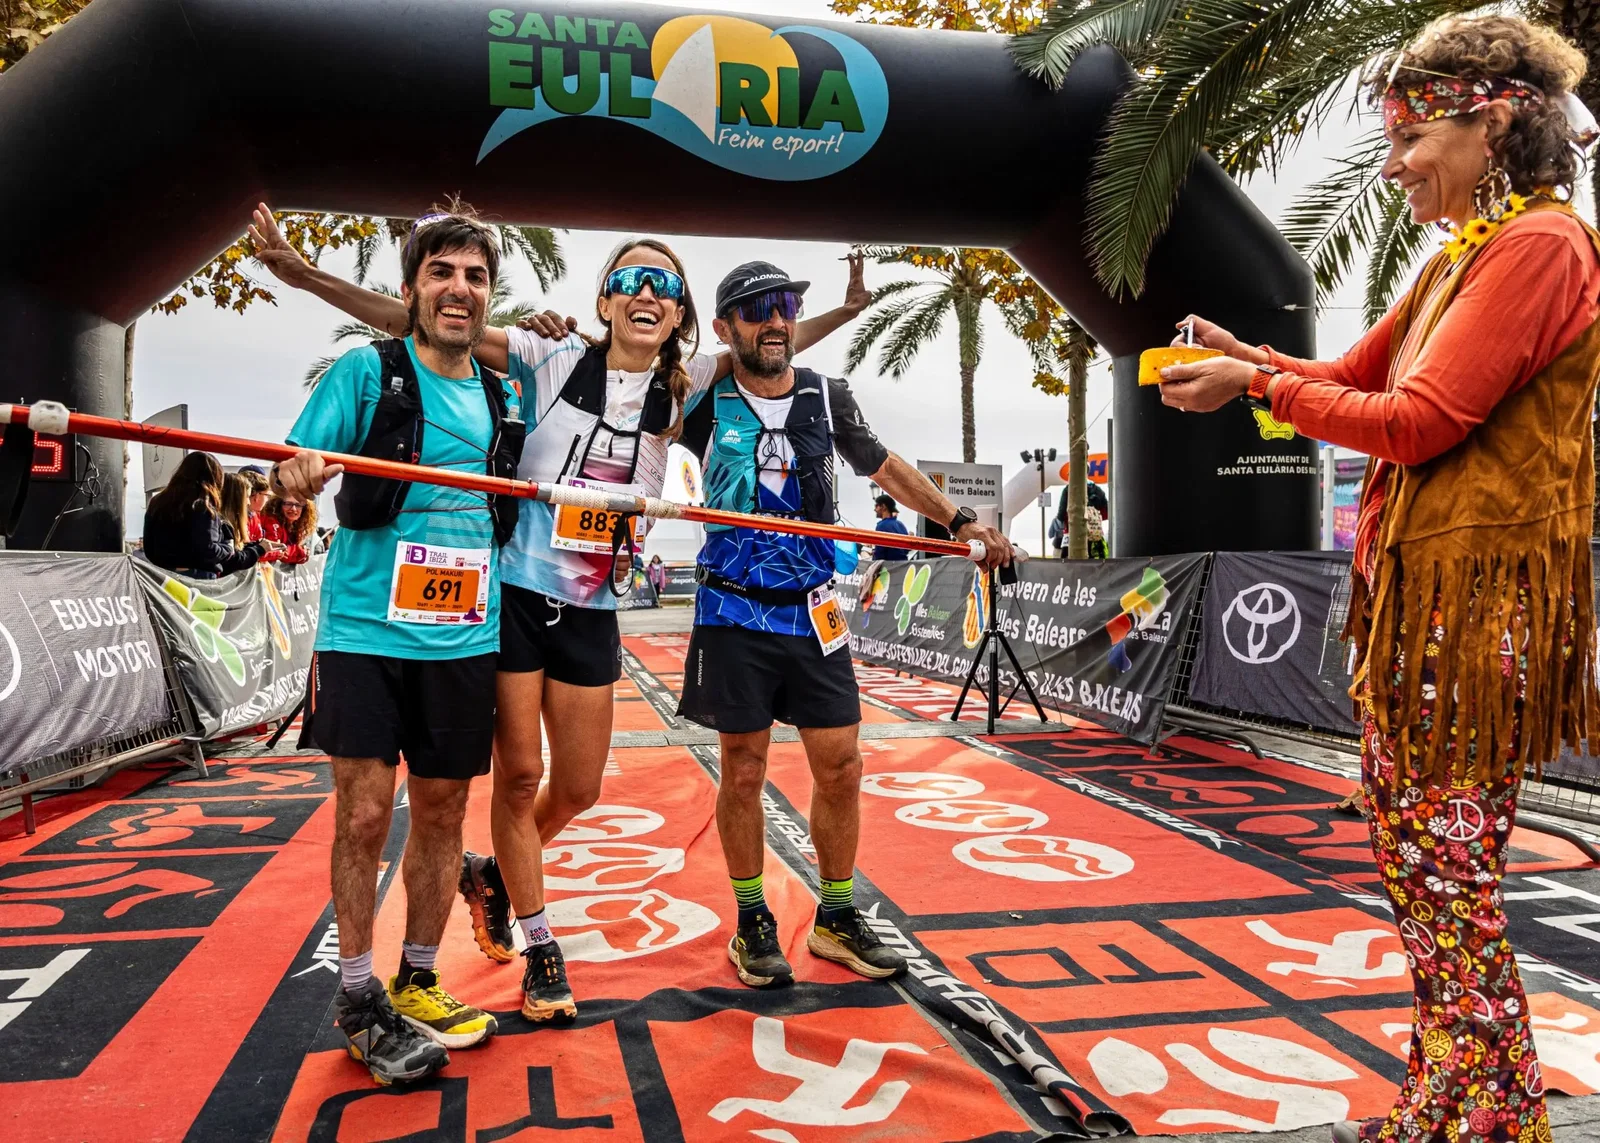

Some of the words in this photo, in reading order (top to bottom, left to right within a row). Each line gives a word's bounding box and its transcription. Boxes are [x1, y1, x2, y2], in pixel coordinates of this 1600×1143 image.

[487, 8, 650, 50] SANTA
[717, 128, 766, 149] Feim
[772, 131, 845, 160] esport!
[743, 272, 789, 287] SALOMON
[1216, 466, 1254, 476] SANTA
[1256, 463, 1295, 474] EULÀRIA
[1296, 466, 1309, 474] DES
[1236, 455, 1300, 464] AJUNTAMENT
[1301, 456, 1310, 464] DE
[948, 475, 974, 485] Govern
[974, 477, 984, 485] de
[984, 477, 996, 486] les
[948, 486, 965, 496] Illes
[967, 487, 996, 497] Balears
[428, 550, 449, 559] TRAIL
[428, 556, 448, 564] IBIZA
[422, 578, 463, 603] 691
[1051, 577, 1069, 606] de
[1074, 578, 1097, 607] les
[49, 596, 138, 632] EBUSUS
[1024, 613, 1087, 649] Balears
[73, 640, 157, 682] MOTOR
